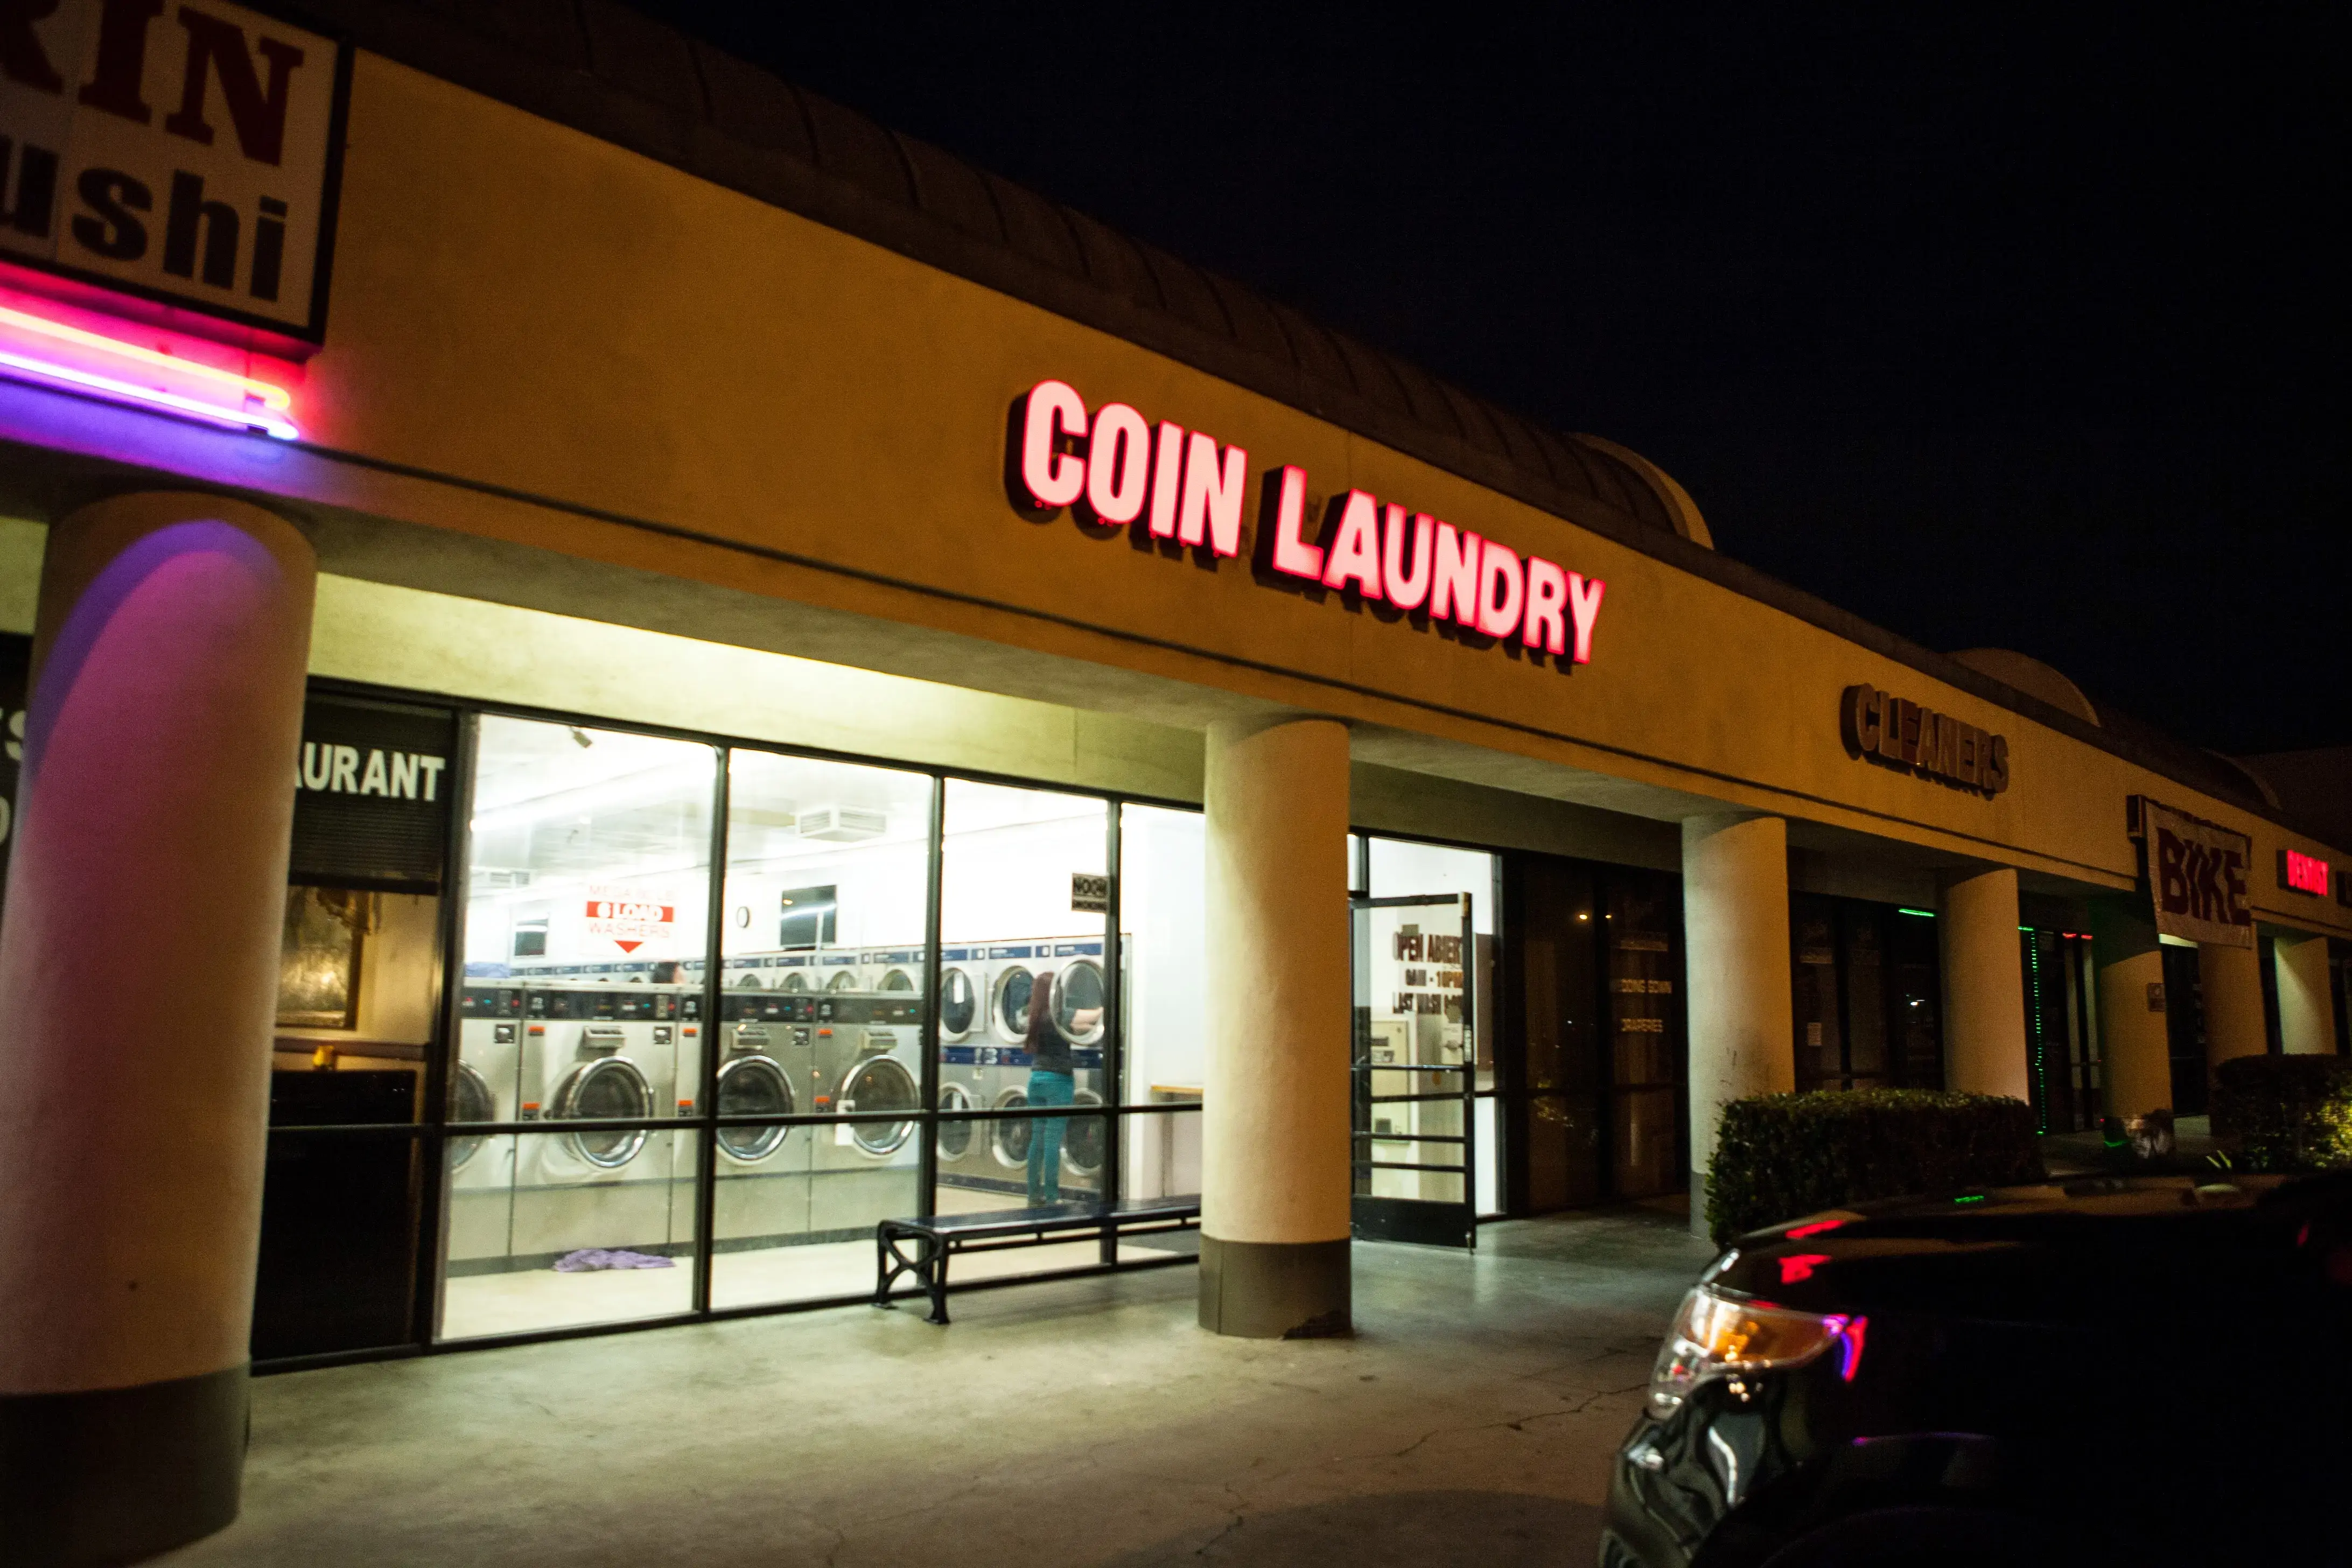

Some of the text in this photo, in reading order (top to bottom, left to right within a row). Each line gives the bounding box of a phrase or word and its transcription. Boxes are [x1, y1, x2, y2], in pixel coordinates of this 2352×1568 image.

[1021, 379, 1606, 665] COIN LAUNDRY
[1852, 683, 2009, 795] CLEANERS
[2155, 826, 2251, 927] BIKE
[613, 902, 664, 922] LOAD
[590, 922, 670, 939] WASHERS
[1392, 931, 1423, 962] OPEN
[1392, 992, 1414, 1014] LAST
[1416, 993, 1441, 1014] WASH
